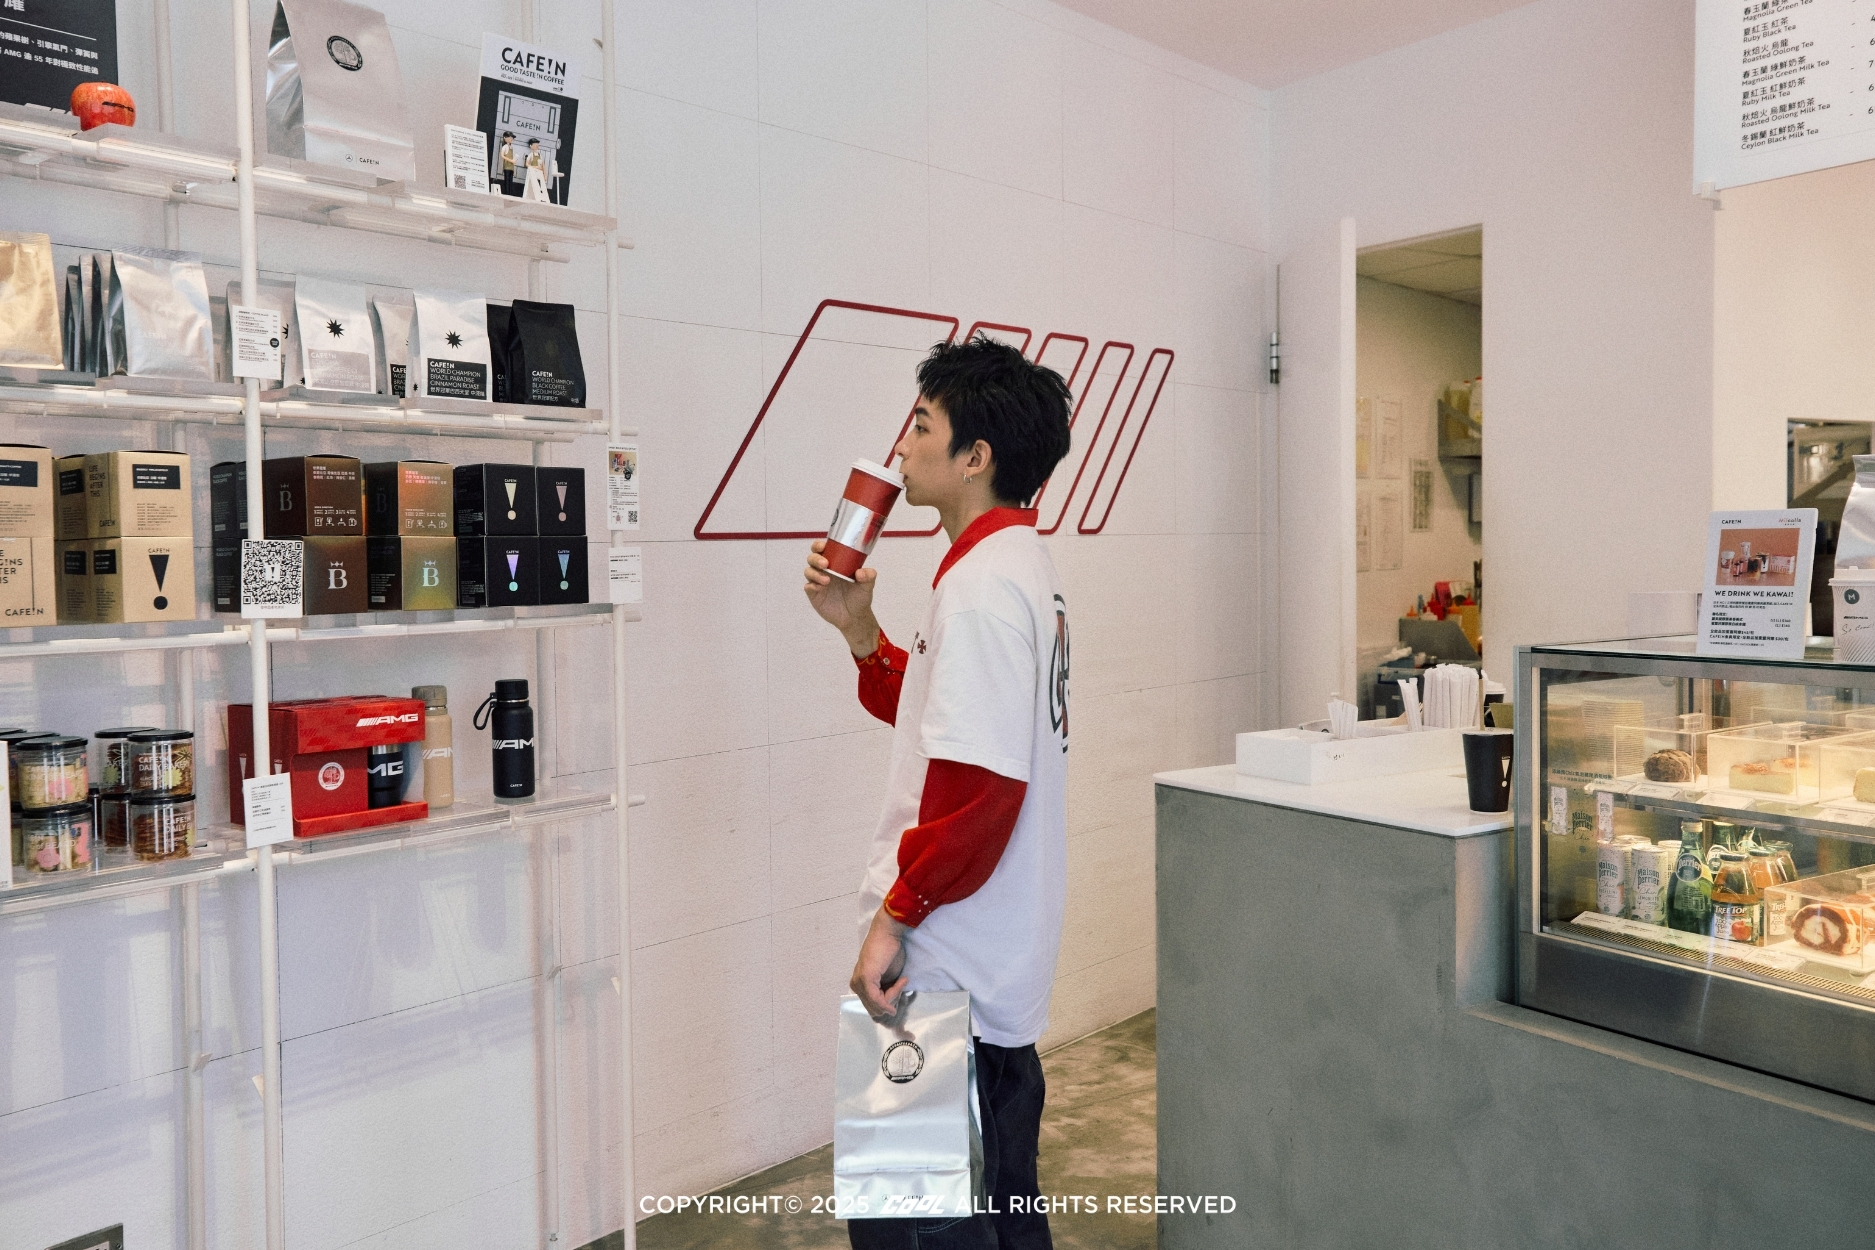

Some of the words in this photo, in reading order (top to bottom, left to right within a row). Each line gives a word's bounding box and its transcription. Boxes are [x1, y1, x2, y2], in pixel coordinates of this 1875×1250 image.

[1743, 9, 1775, 22] Magnolia
[1776, 2, 1799, 13] Green
[1771, 16, 1789, 29] 紅茶
[1743, 34, 1761, 44] Ruby
[1762, 28, 1782, 39] Black
[1784, 23, 1797, 32] Tea
[3, 48, 22, 58] AMG
[33, 54, 44, 63] 55
[501, 46, 567, 77] CAFE!N
[1742, 52, 1771, 65] Roasted
[1772, 45, 1800, 57] Oolong
[1801, 41, 1814, 50] Tea
[1869, 59, 1874, 68] 7
[500, 63, 519, 74] GOOD
[519, 68, 536, 79] TASTE
[543, 74, 566, 86] COFFEE
[1742, 73, 1774, 87] Magnolia
[1775, 68, 1798, 79] Green
[1799, 61, 1815, 72] Milk
[1816, 59, 1830, 68] Tea
[1769, 76, 1806, 93] 紅鮮奶茶
[1741, 97, 1760, 107] Ruby
[1761, 92, 1777, 102] Milk
[1778, 90, 1791, 98] Tea
[1741, 117, 1770, 129] Roasted
[1771, 112, 1799, 123] Oolong
[1800, 107, 1816, 115] Milk
[1817, 103, 1831, 112] Tea
[516, 120, 541, 131] CAFE!N
[1769, 121, 1806, 137] 紅鮮奶茶
[1741, 140, 1766, 151] Ceylon
[1767, 135, 1787, 145] Black
[1788, 131, 1804, 140] Milk
[1806, 128, 1819, 137] Tea
[430, 361, 455, 369] CAFE!N
[430, 380, 462, 388] CINNAMON
[328, 568, 348, 590] B
[423, 567, 440, 587] B
[5, 607, 44, 617] CAFE!N
[1637, 868, 1660, 878] Maison
[1714, 906, 1731, 914] TREE
[1731, 906, 1748, 915] TOP
